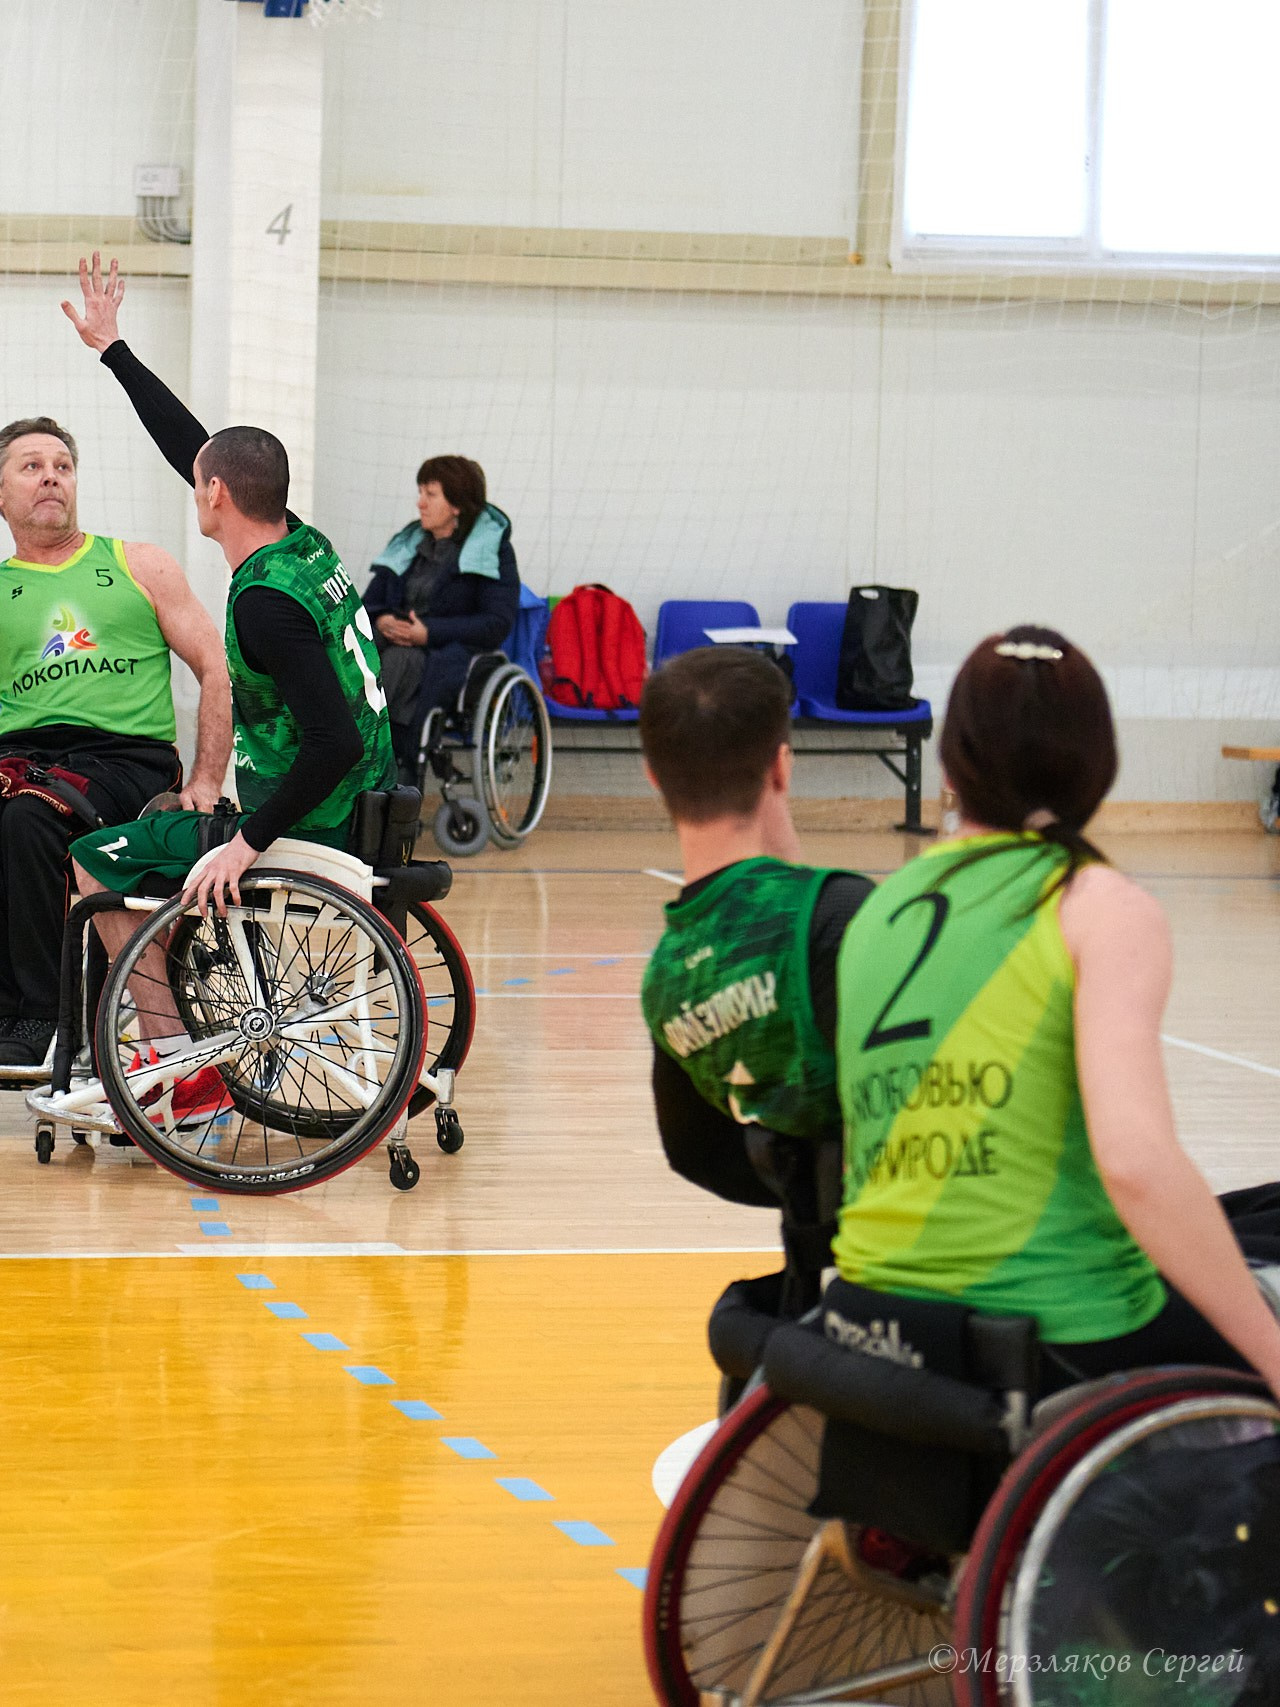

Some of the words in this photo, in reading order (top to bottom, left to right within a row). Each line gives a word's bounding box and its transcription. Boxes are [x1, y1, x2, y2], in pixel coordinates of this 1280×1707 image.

[265, 203, 293, 245] 4
[95, 568, 114, 587] 5
[12, 657, 139, 698] ЛОКОПЛАСТ
[863, 892, 951, 1052] 2
